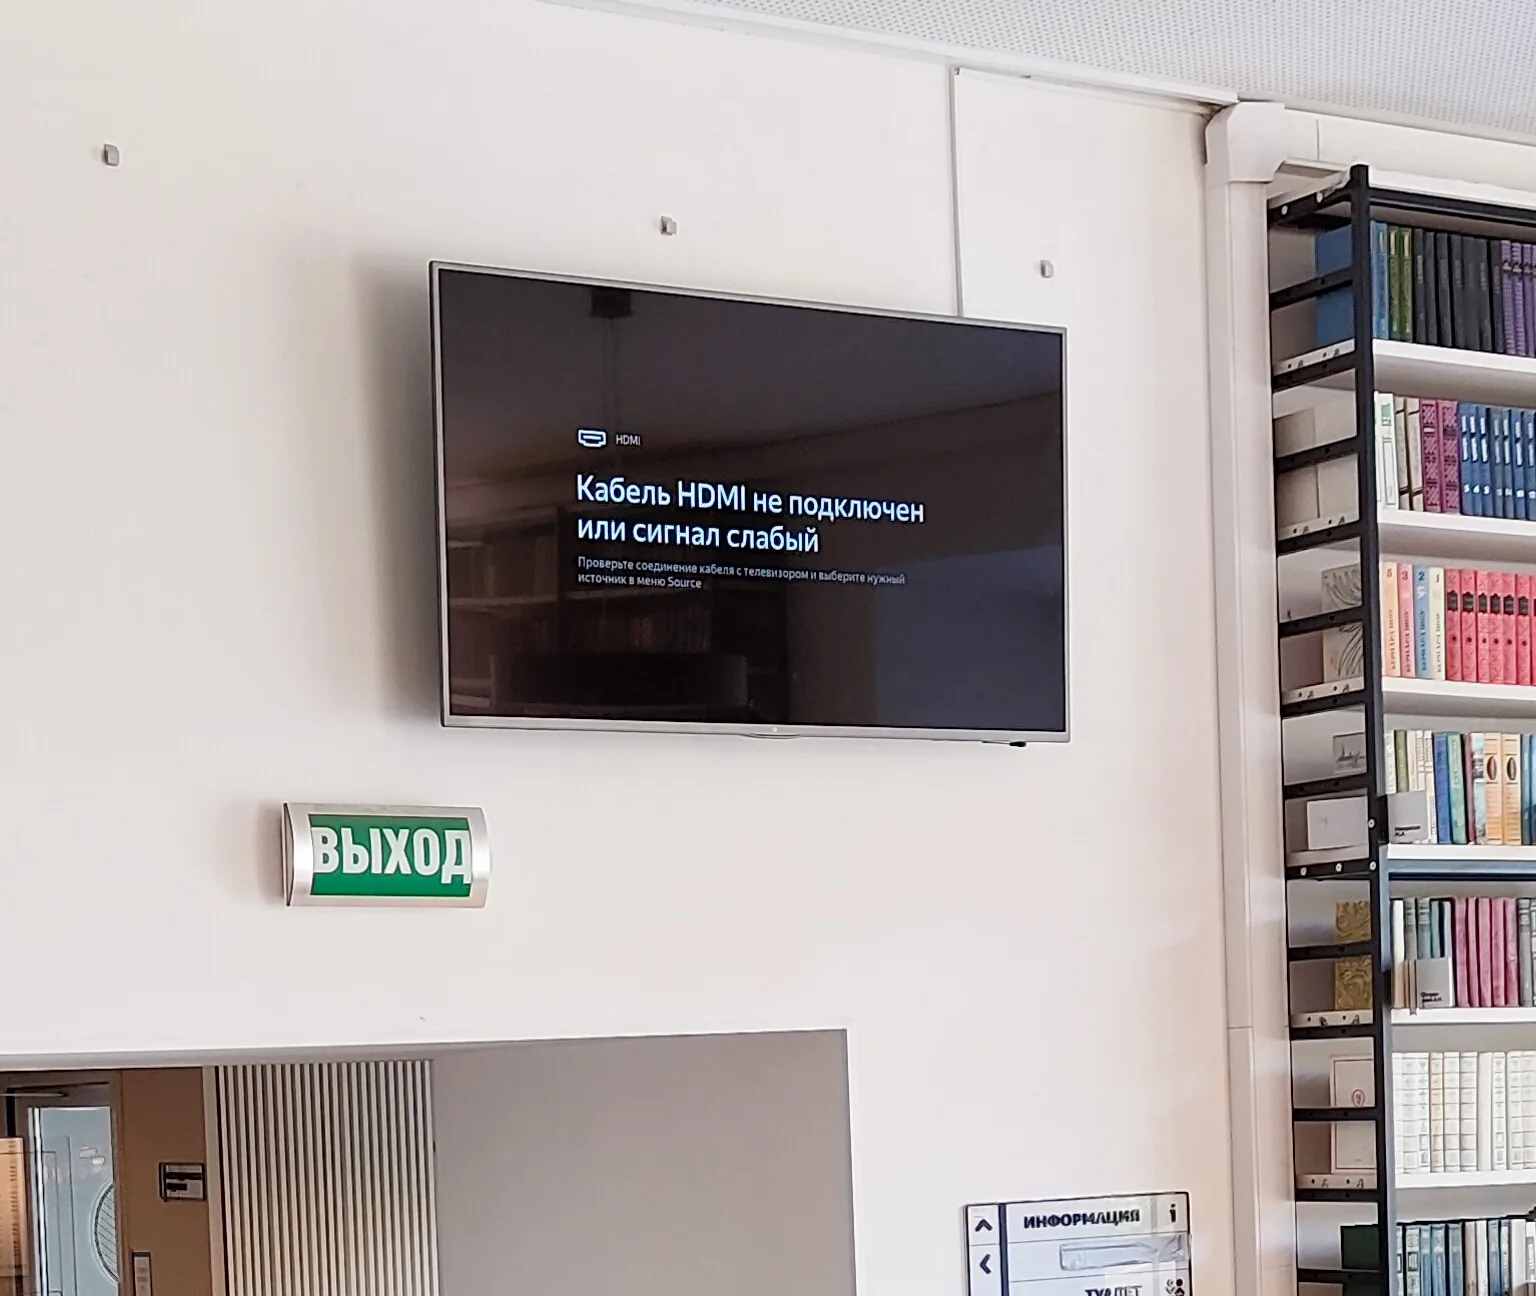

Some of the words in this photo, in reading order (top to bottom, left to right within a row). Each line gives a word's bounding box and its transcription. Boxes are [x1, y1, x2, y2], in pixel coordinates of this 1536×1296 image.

[616, 434, 641, 445] HDMI
[577, 474, 671, 505] Кабель
[678, 480, 746, 511] HDMI
[753, 492, 782, 513] не
[789, 495, 924, 522] подключен
[578, 518, 625, 541] или
[633, 523, 720, 547] сигнал
[727, 526, 819, 553] слабый
[578, 556, 634, 570] Проверьте
[636, 562, 697, 573] соединение
[699, 564, 735, 576] кабеля
[744, 567, 809, 580] телевизором
[811, 571, 817, 580] и
[819, 570, 865, 583] выберите
[867, 573, 905, 585] нужный
[578, 573, 627, 585] источник
[629, 576, 635, 585] в
[637, 577, 666, 587] меню
[668, 576, 702, 589] Source
[311, 826, 472, 884] ВЫХОД
[1023, 1209, 1140, 1229] ИНФОРМАЦИЯ
